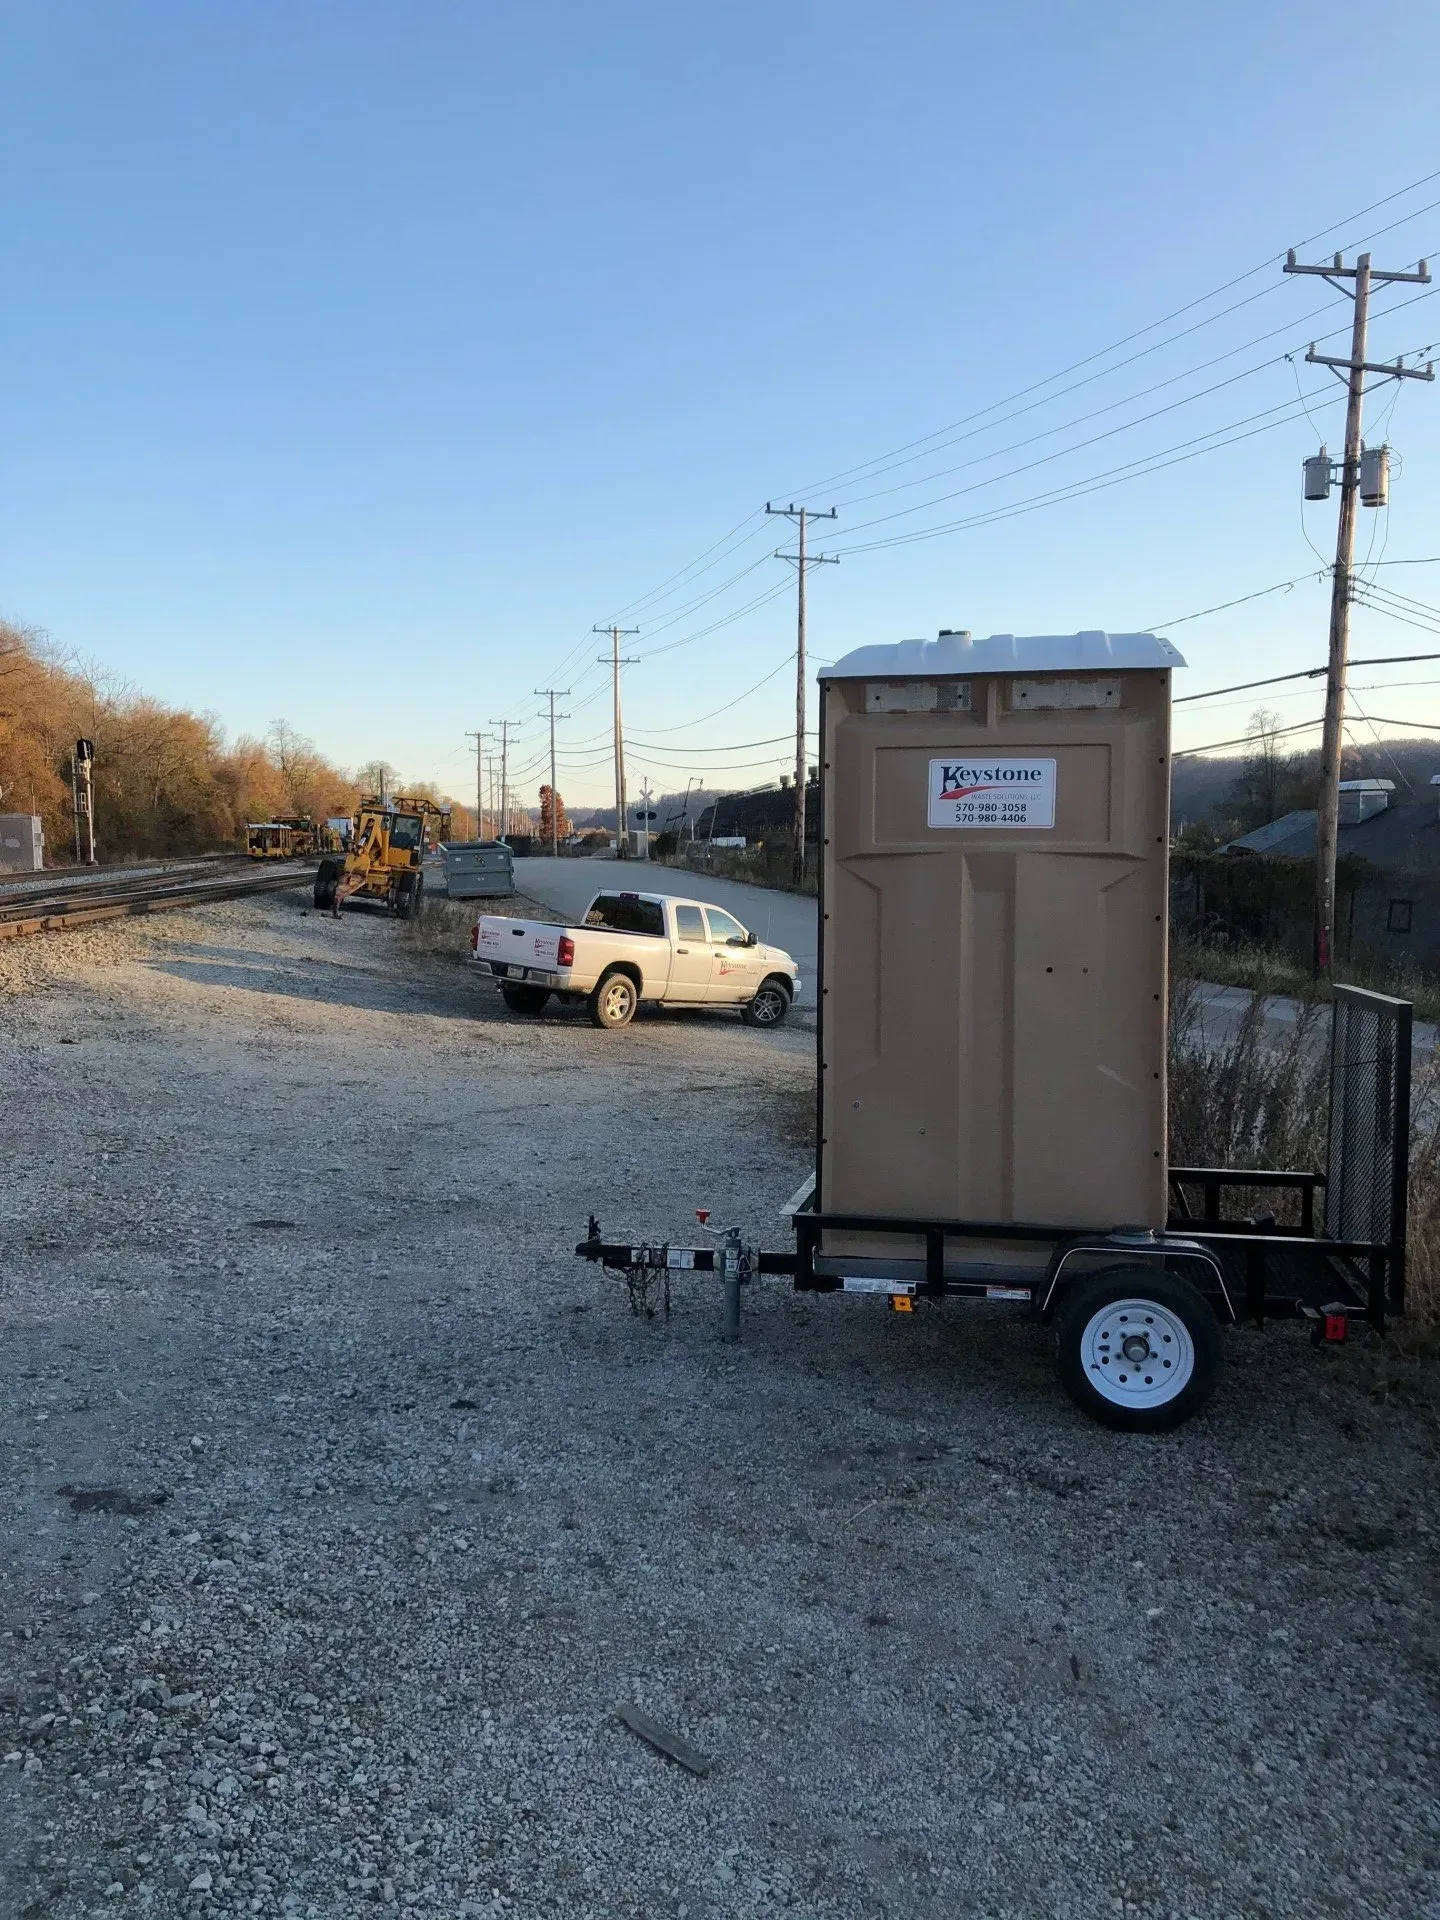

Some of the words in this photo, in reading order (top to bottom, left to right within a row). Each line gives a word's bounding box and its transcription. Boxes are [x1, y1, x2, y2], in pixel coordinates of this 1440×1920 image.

[940, 766, 1042, 796] Keystone
[955, 803, 1027, 812] 570-980-3058
[955, 814, 1027, 823] 570-980-4406
[720, 961, 747, 971] Keystone
